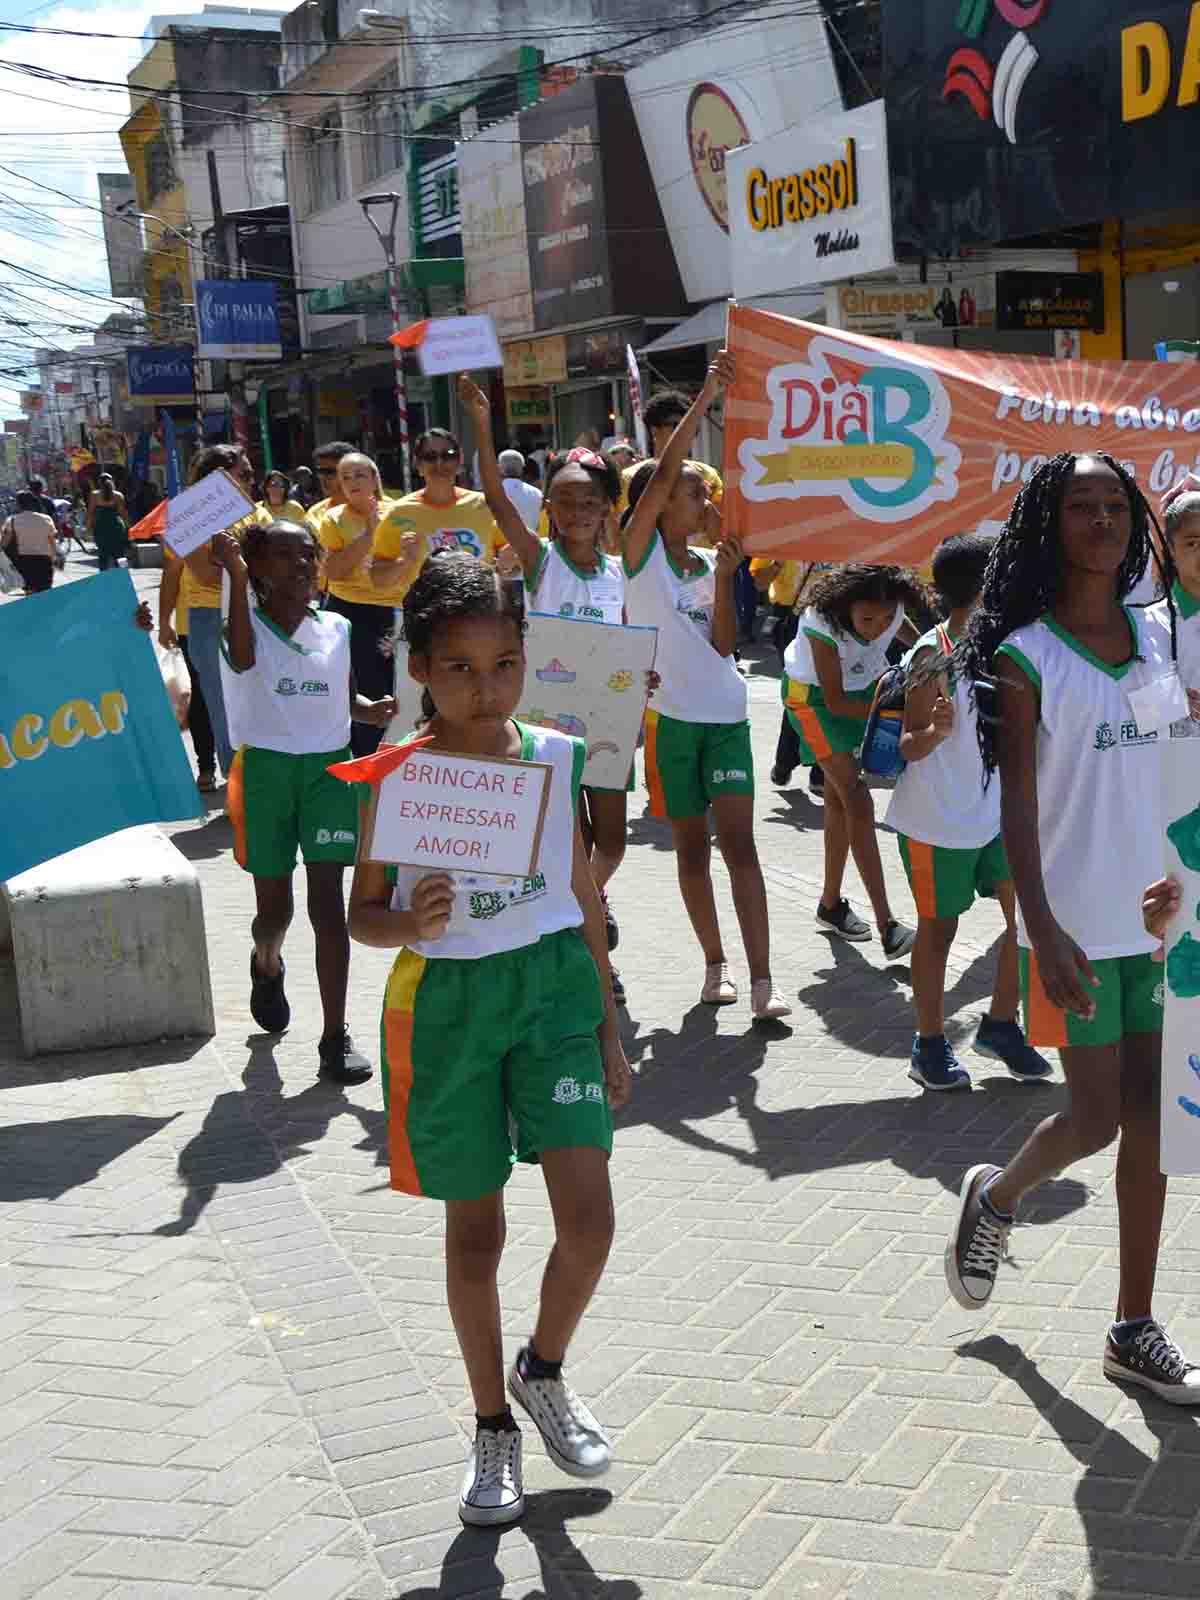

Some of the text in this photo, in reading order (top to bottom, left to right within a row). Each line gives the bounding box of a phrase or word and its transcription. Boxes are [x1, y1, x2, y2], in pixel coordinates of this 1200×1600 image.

[995, 385, 1100, 427] Feira
[402, 761, 528, 796] BRINCAR É
[399, 799, 517, 831] EXPRESSAR
[413, 835, 491, 860] AMOR!
